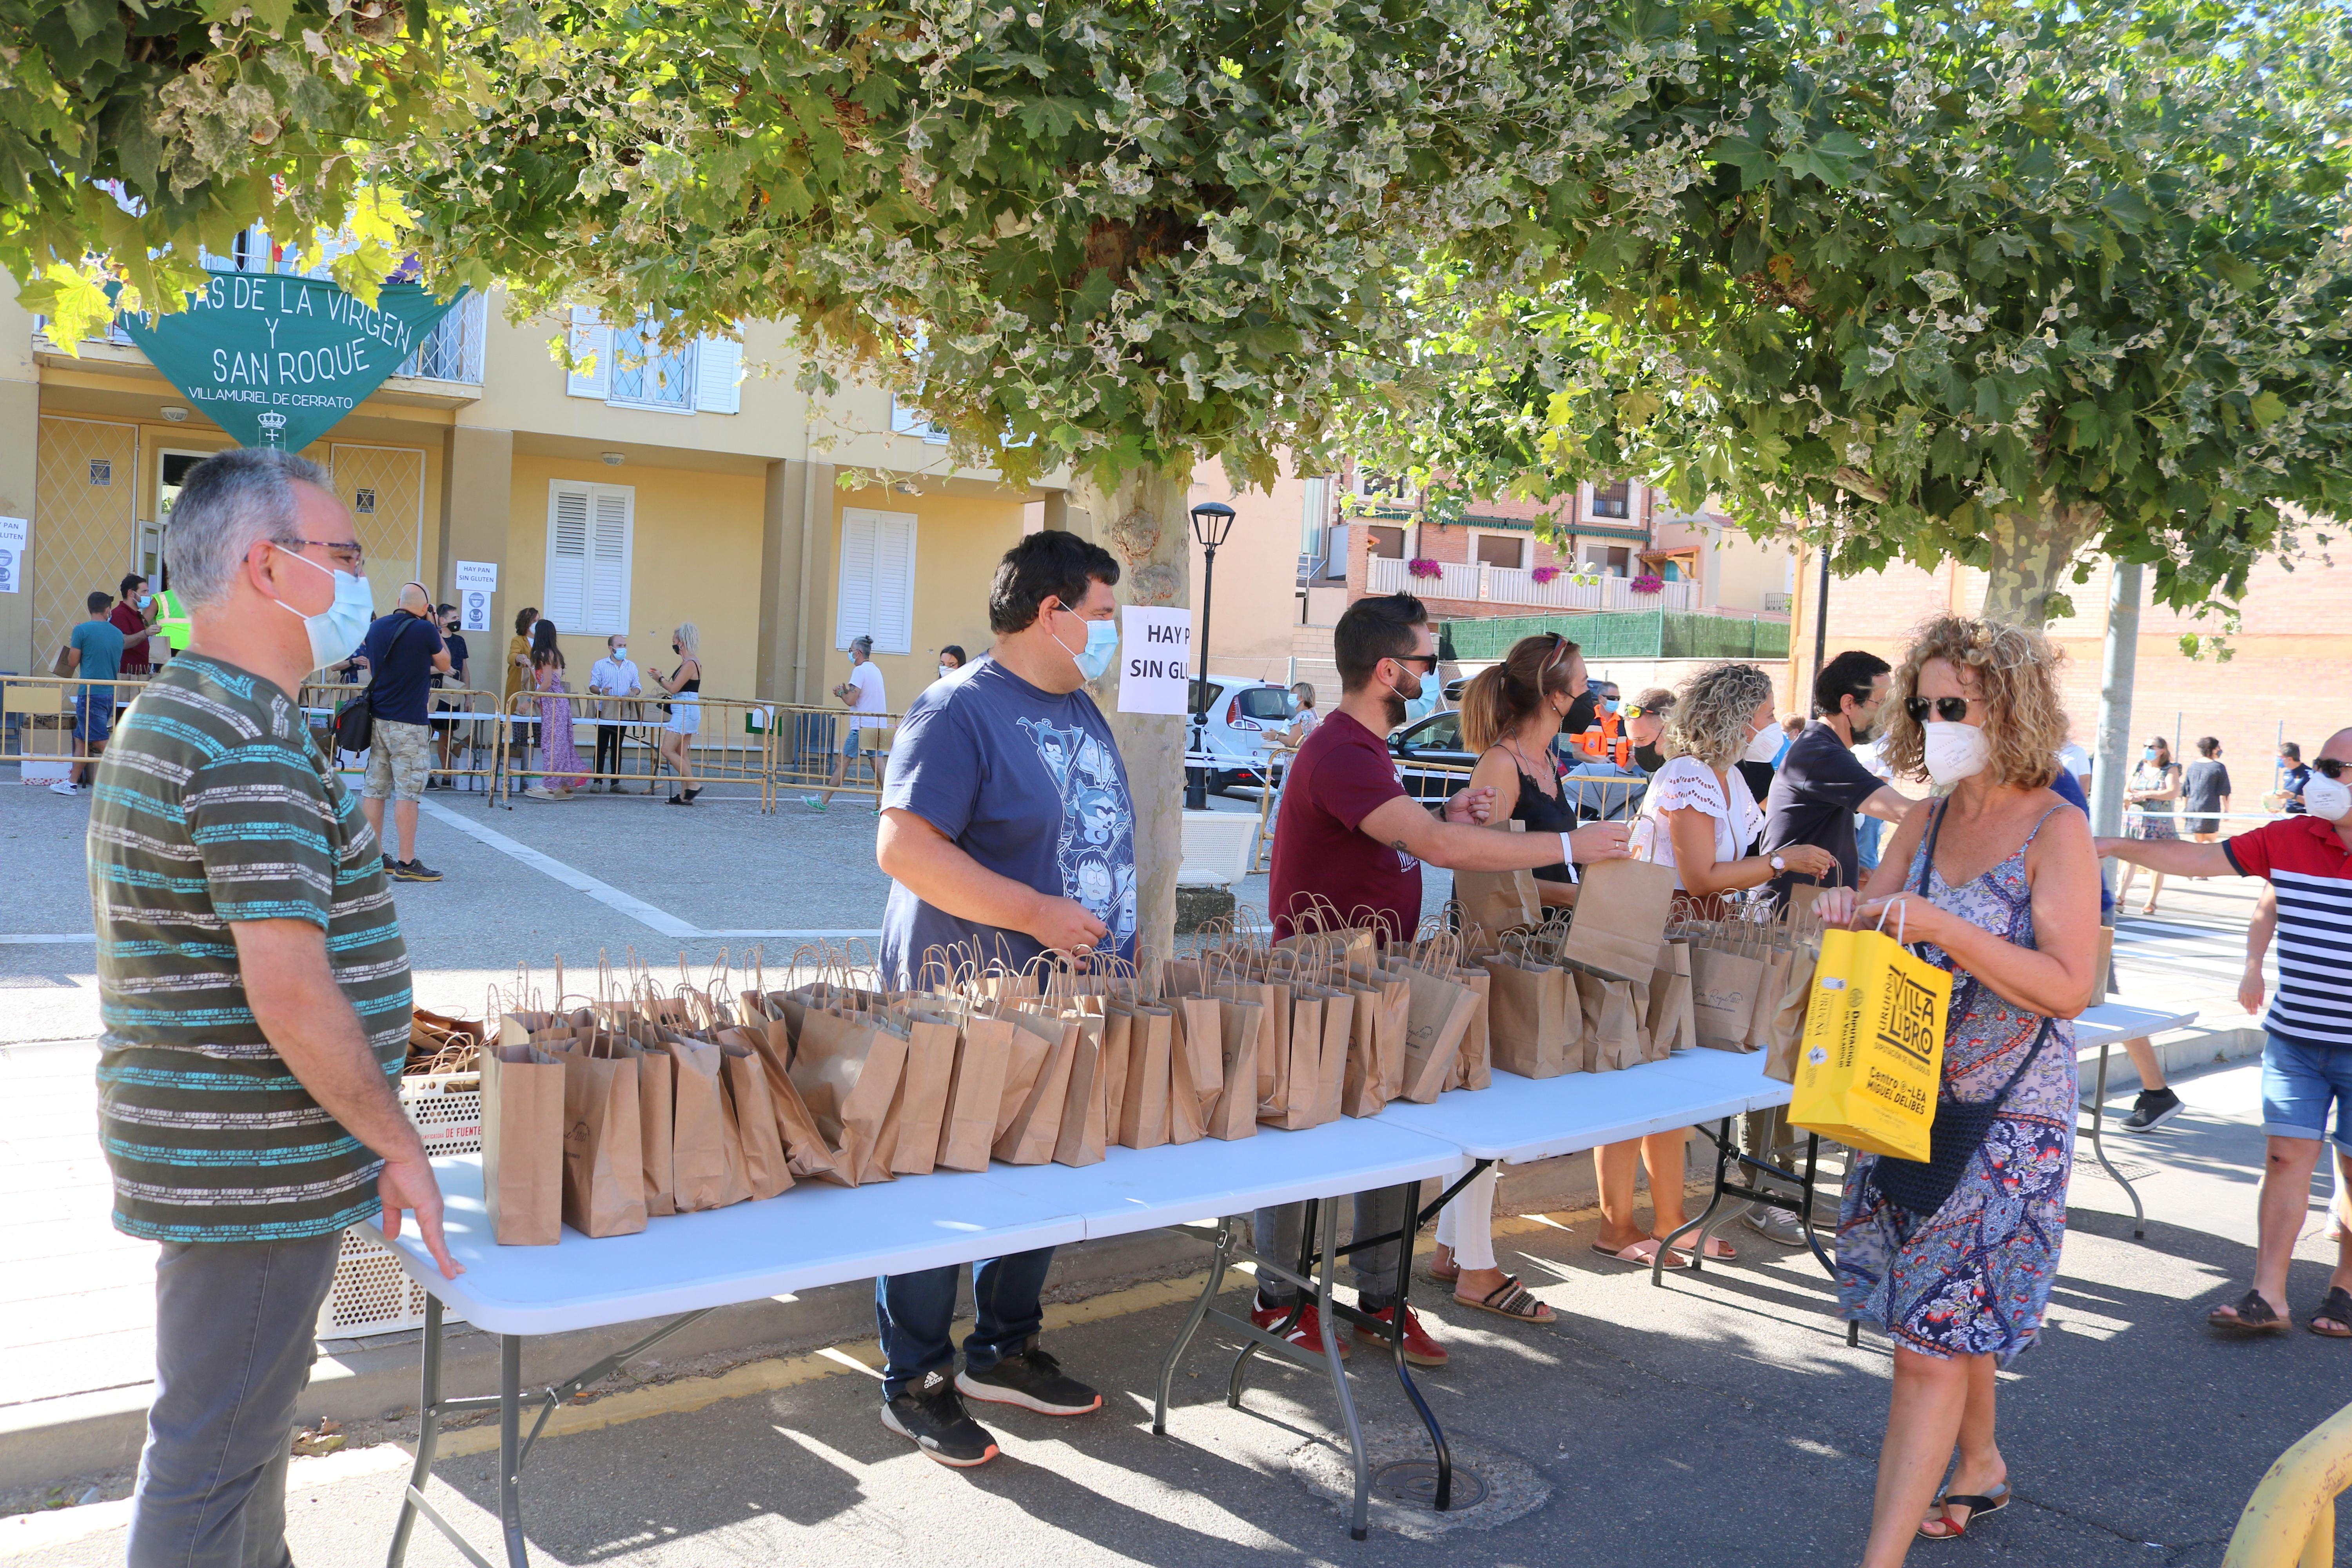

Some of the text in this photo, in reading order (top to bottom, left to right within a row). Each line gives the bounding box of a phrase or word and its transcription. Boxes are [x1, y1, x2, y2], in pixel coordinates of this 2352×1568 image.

[234, 276, 267, 311] DE
[281, 281, 313, 317] LA
[327, 289, 412, 355] VIRGEN
[265, 317, 279, 349] Y
[213, 337, 370, 386] SAN ROQUE
[188, 387, 353, 409] VILLAMURIEL DE CERRATO
[1148, 624, 1190, 644] HAY P
[1130, 659, 1163, 678] SIN
[1893, 972, 1934, 1026] VILLA
[1889, 1004, 1933, 1055] LIBRO
[1869, 1065, 1899, 1089] Centro
[1866, 1078, 1926, 1115] MIGUEL DELIBES
[446, 1128, 454, 1138] DE
[456, 1126, 481, 1137] FUENTE
[924, 1376, 944, 1389] adidas
